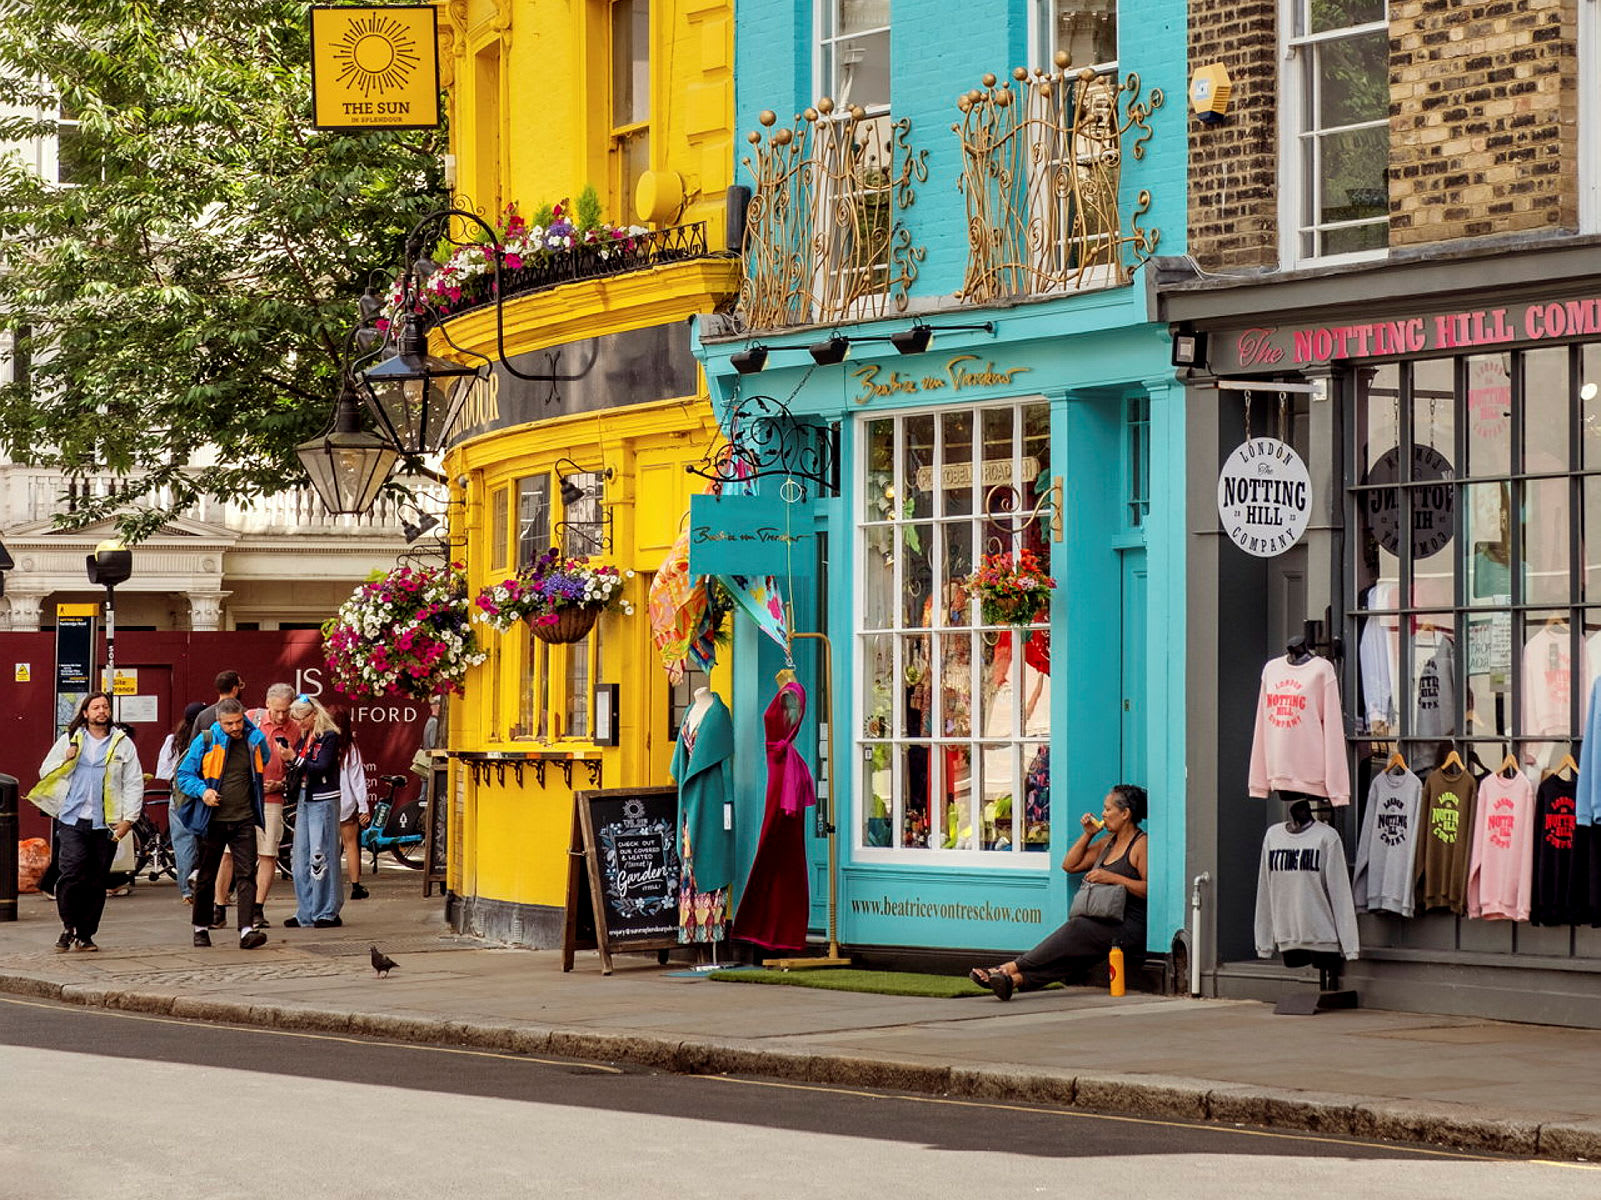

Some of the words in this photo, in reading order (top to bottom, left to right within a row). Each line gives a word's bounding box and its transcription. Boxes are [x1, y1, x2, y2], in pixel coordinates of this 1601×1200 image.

[342, 102, 373, 114] THE
[377, 101, 410, 114] SUN
[1237, 327, 1285, 368] The
[1292, 318, 1427, 364] NOTTING
[1434, 308, 1514, 349] HILL
[1525, 299, 1601, 340] COM
[1240, 442, 1293, 466] LONDON
[984, 463, 1011, 481] ROAD
[1223, 476, 1306, 512] NOTTING
[1246, 505, 1283, 526] HILL
[1232, 526, 1296, 553] COMPANY
[1266, 694, 1306, 711] NOTTING
[641, 839, 655, 847] OUT
[617, 861, 669, 897] Garden
[851, 896, 1042, 924] www.beatricevontresckow.com
